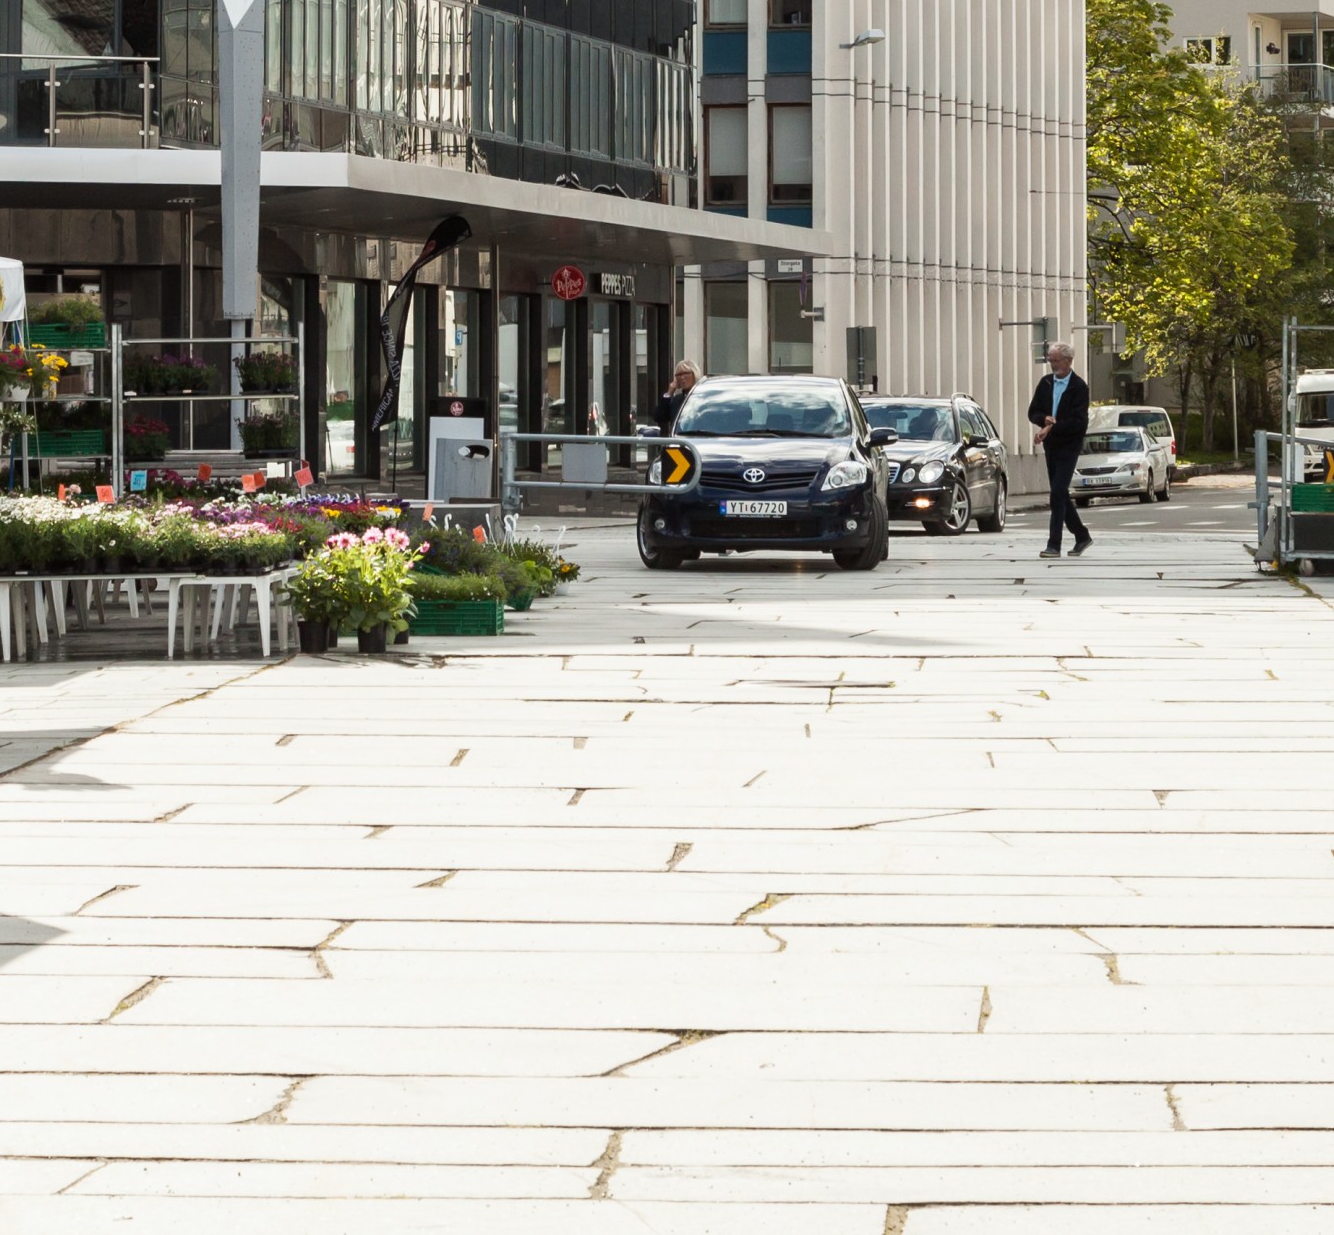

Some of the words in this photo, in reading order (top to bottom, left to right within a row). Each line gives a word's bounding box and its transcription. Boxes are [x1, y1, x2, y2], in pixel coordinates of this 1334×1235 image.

[601, 273, 621, 296] PEPPES
[622, 275, 636, 297] PIZZA
[730, 502, 744, 514] YT
[750, 503, 785, 514] 67720
